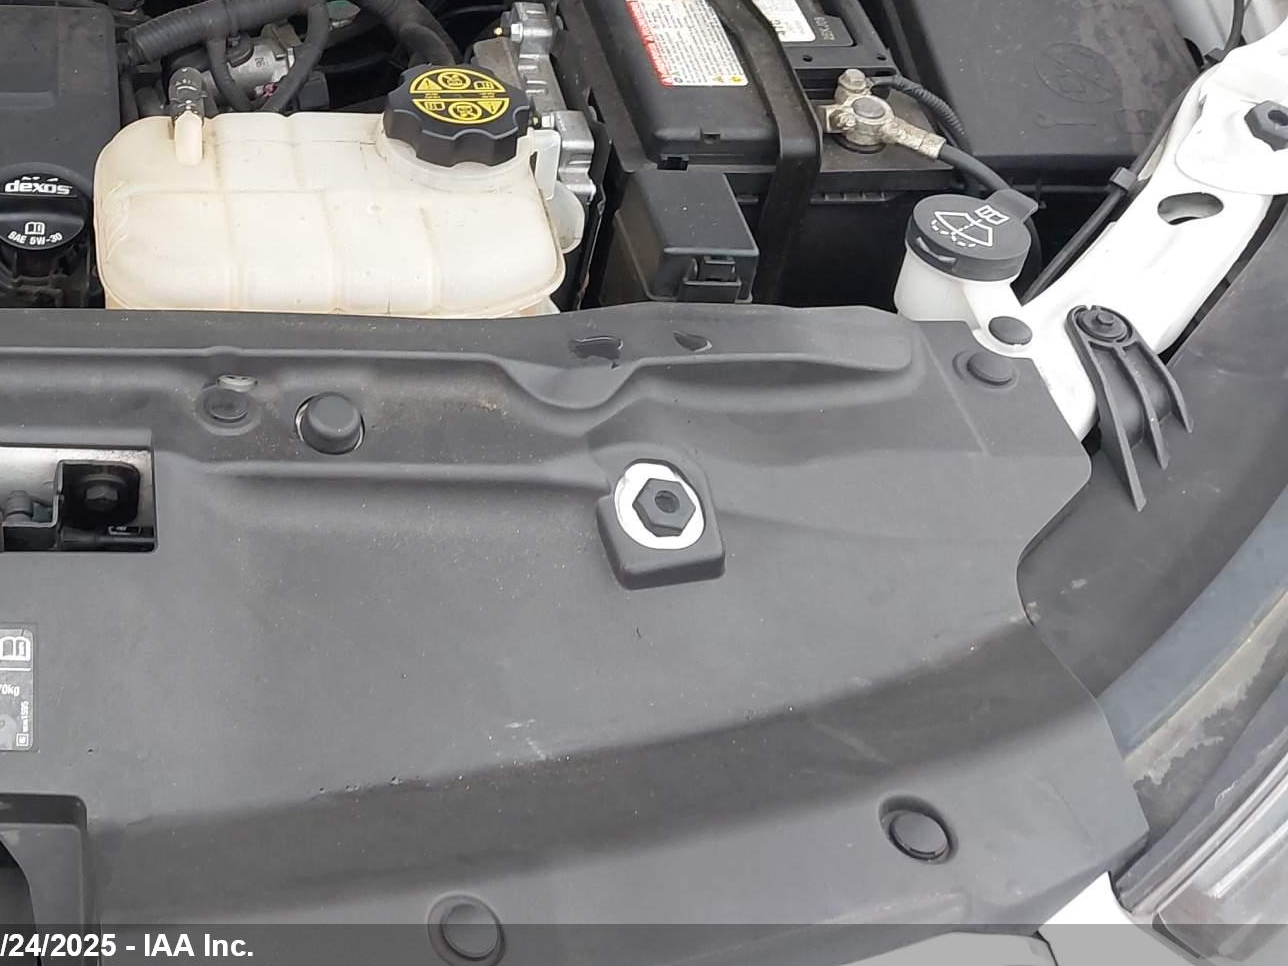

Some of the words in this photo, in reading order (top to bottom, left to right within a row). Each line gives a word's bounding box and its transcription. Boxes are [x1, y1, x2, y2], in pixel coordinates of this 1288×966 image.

[4, 179, 72, 195] dexos
[8, 231, 27, 244] SAE
[29, 232, 63, 245] 5W-30
